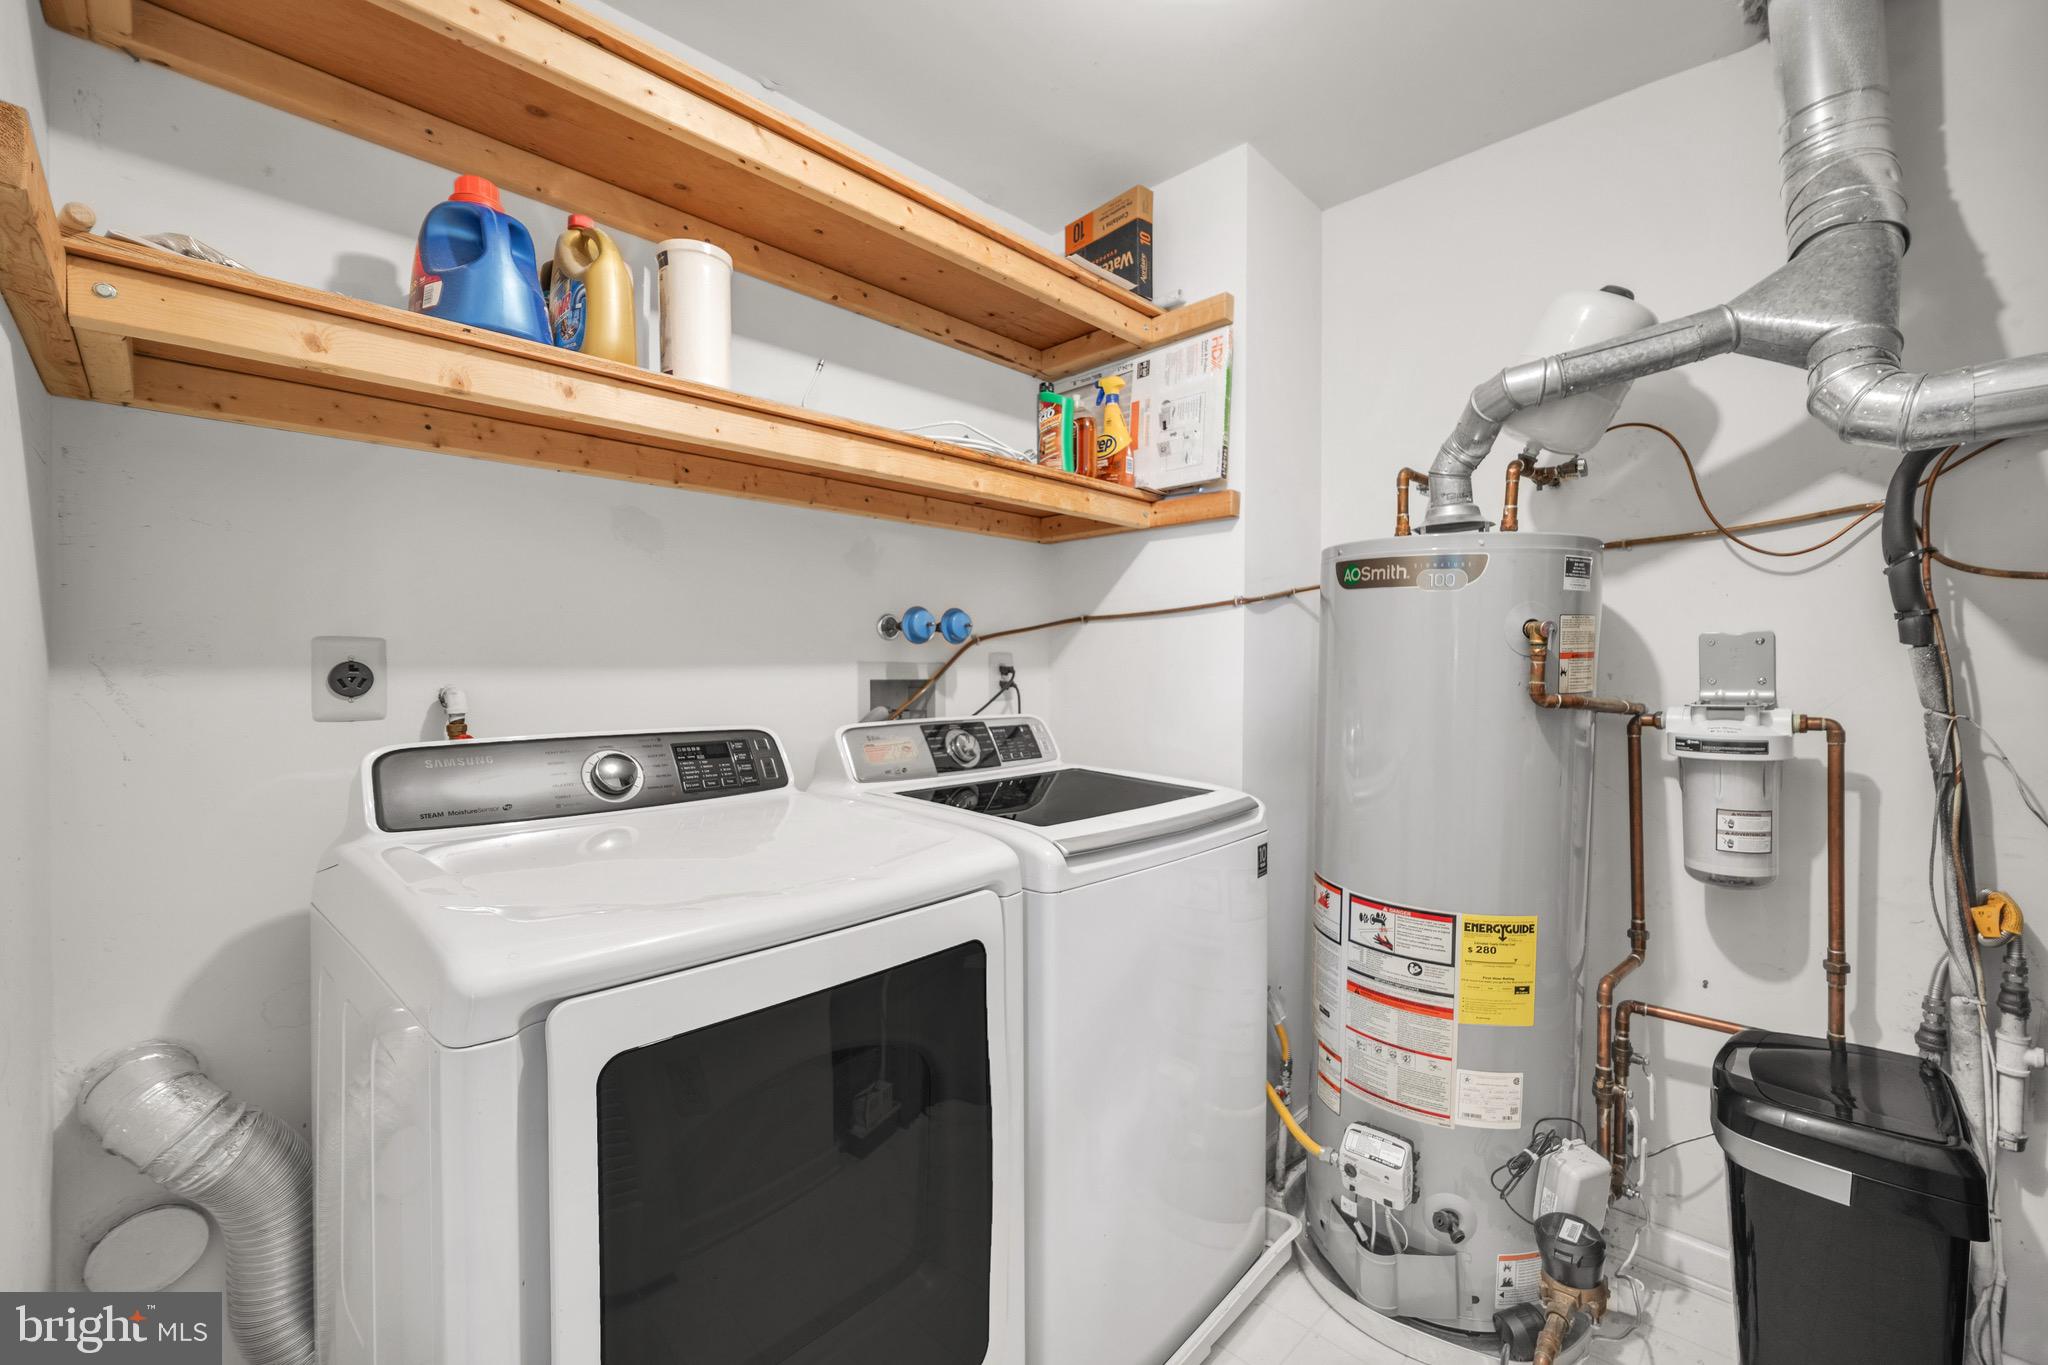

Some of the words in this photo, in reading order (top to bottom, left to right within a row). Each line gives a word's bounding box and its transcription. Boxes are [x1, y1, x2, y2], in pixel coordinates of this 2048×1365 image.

[1073, 221, 1085, 243] 10
[1140, 231, 1151, 246] 10
[1103, 251, 1134, 273] Wate
[1429, 573, 1456, 587] 100
[424, 756, 494, 769] SAMSUNG
[420, 810, 445, 819] STEAM
[448, 806, 500, 817] MoistureSensor
[1476, 945, 1497, 955] 280
